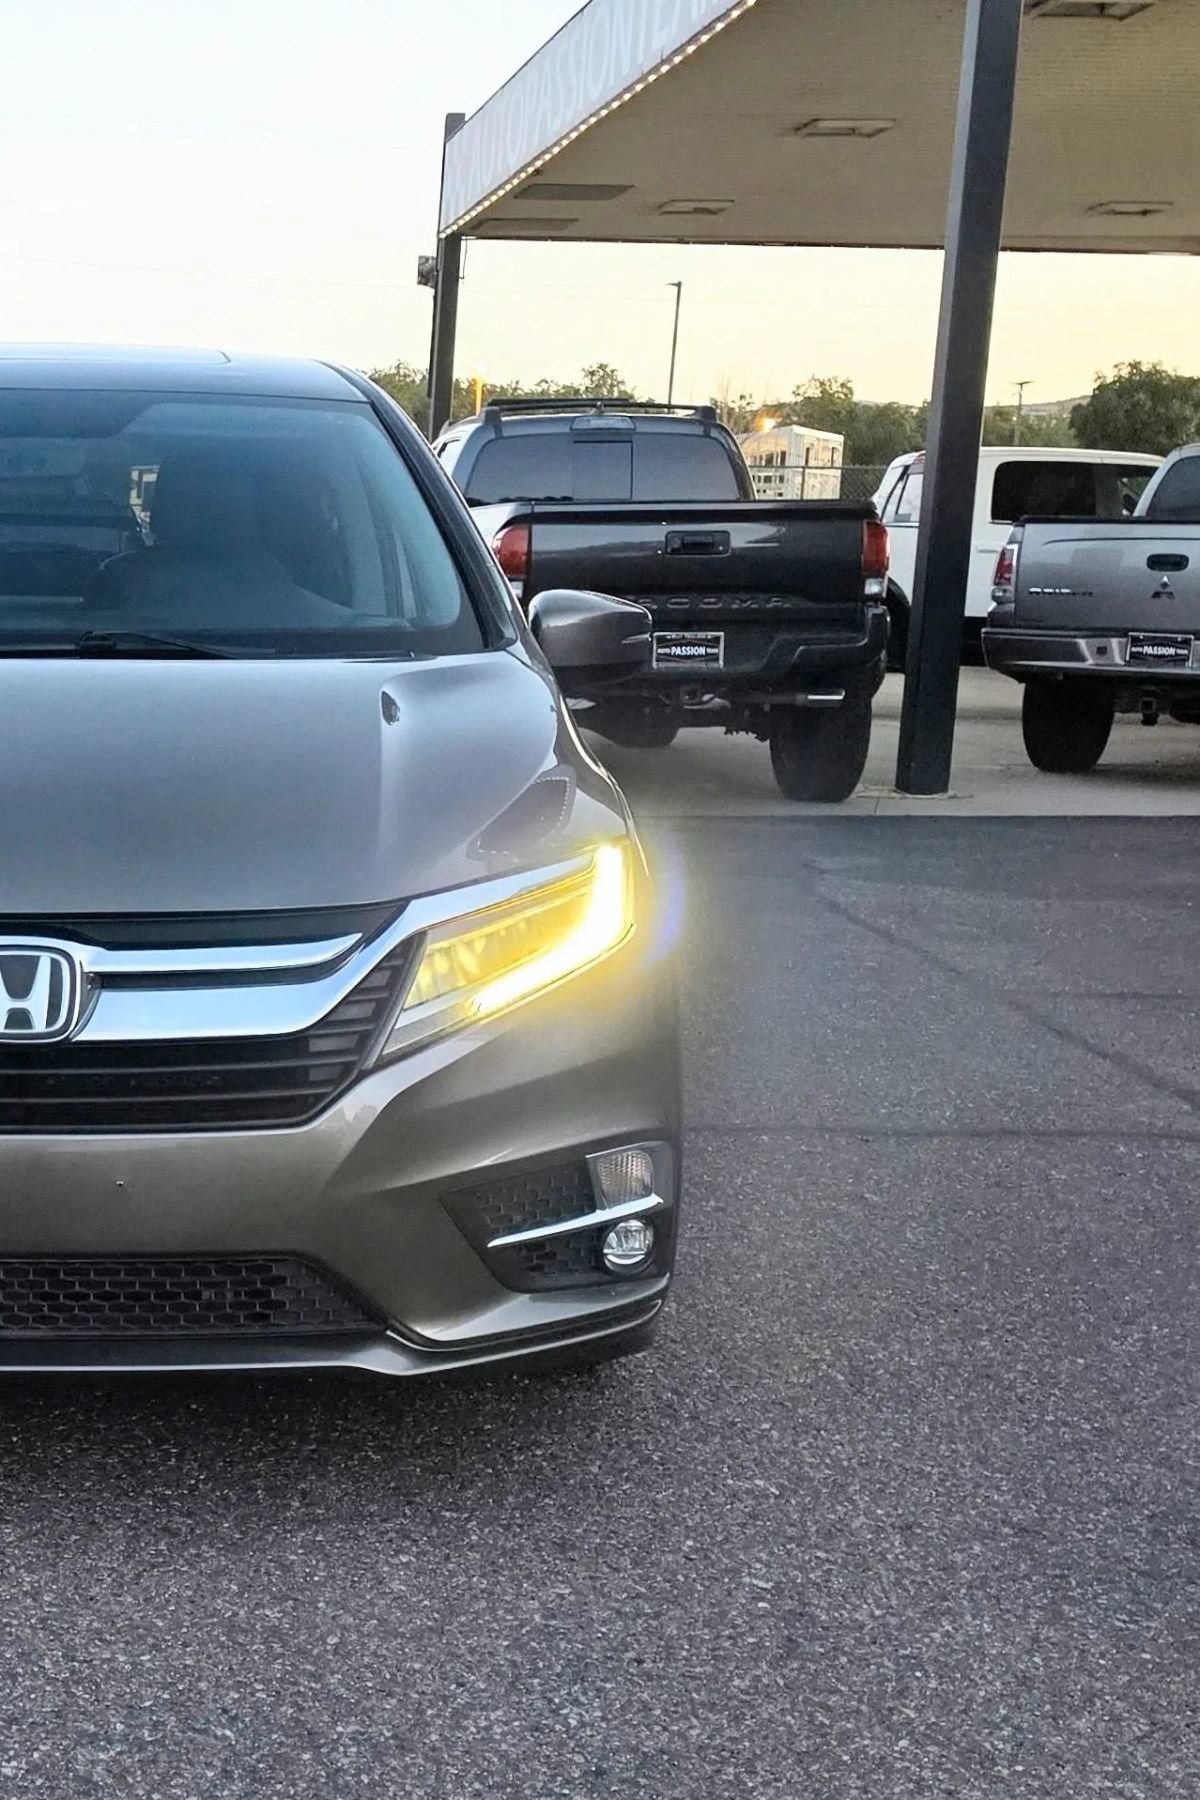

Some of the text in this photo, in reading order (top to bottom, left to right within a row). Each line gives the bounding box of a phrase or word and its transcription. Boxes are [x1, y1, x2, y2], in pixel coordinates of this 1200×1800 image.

[625, 594, 791, 608] ACOMA
[671, 646, 706, 655] PASSION
[1143, 646, 1176, 656] PASSION
